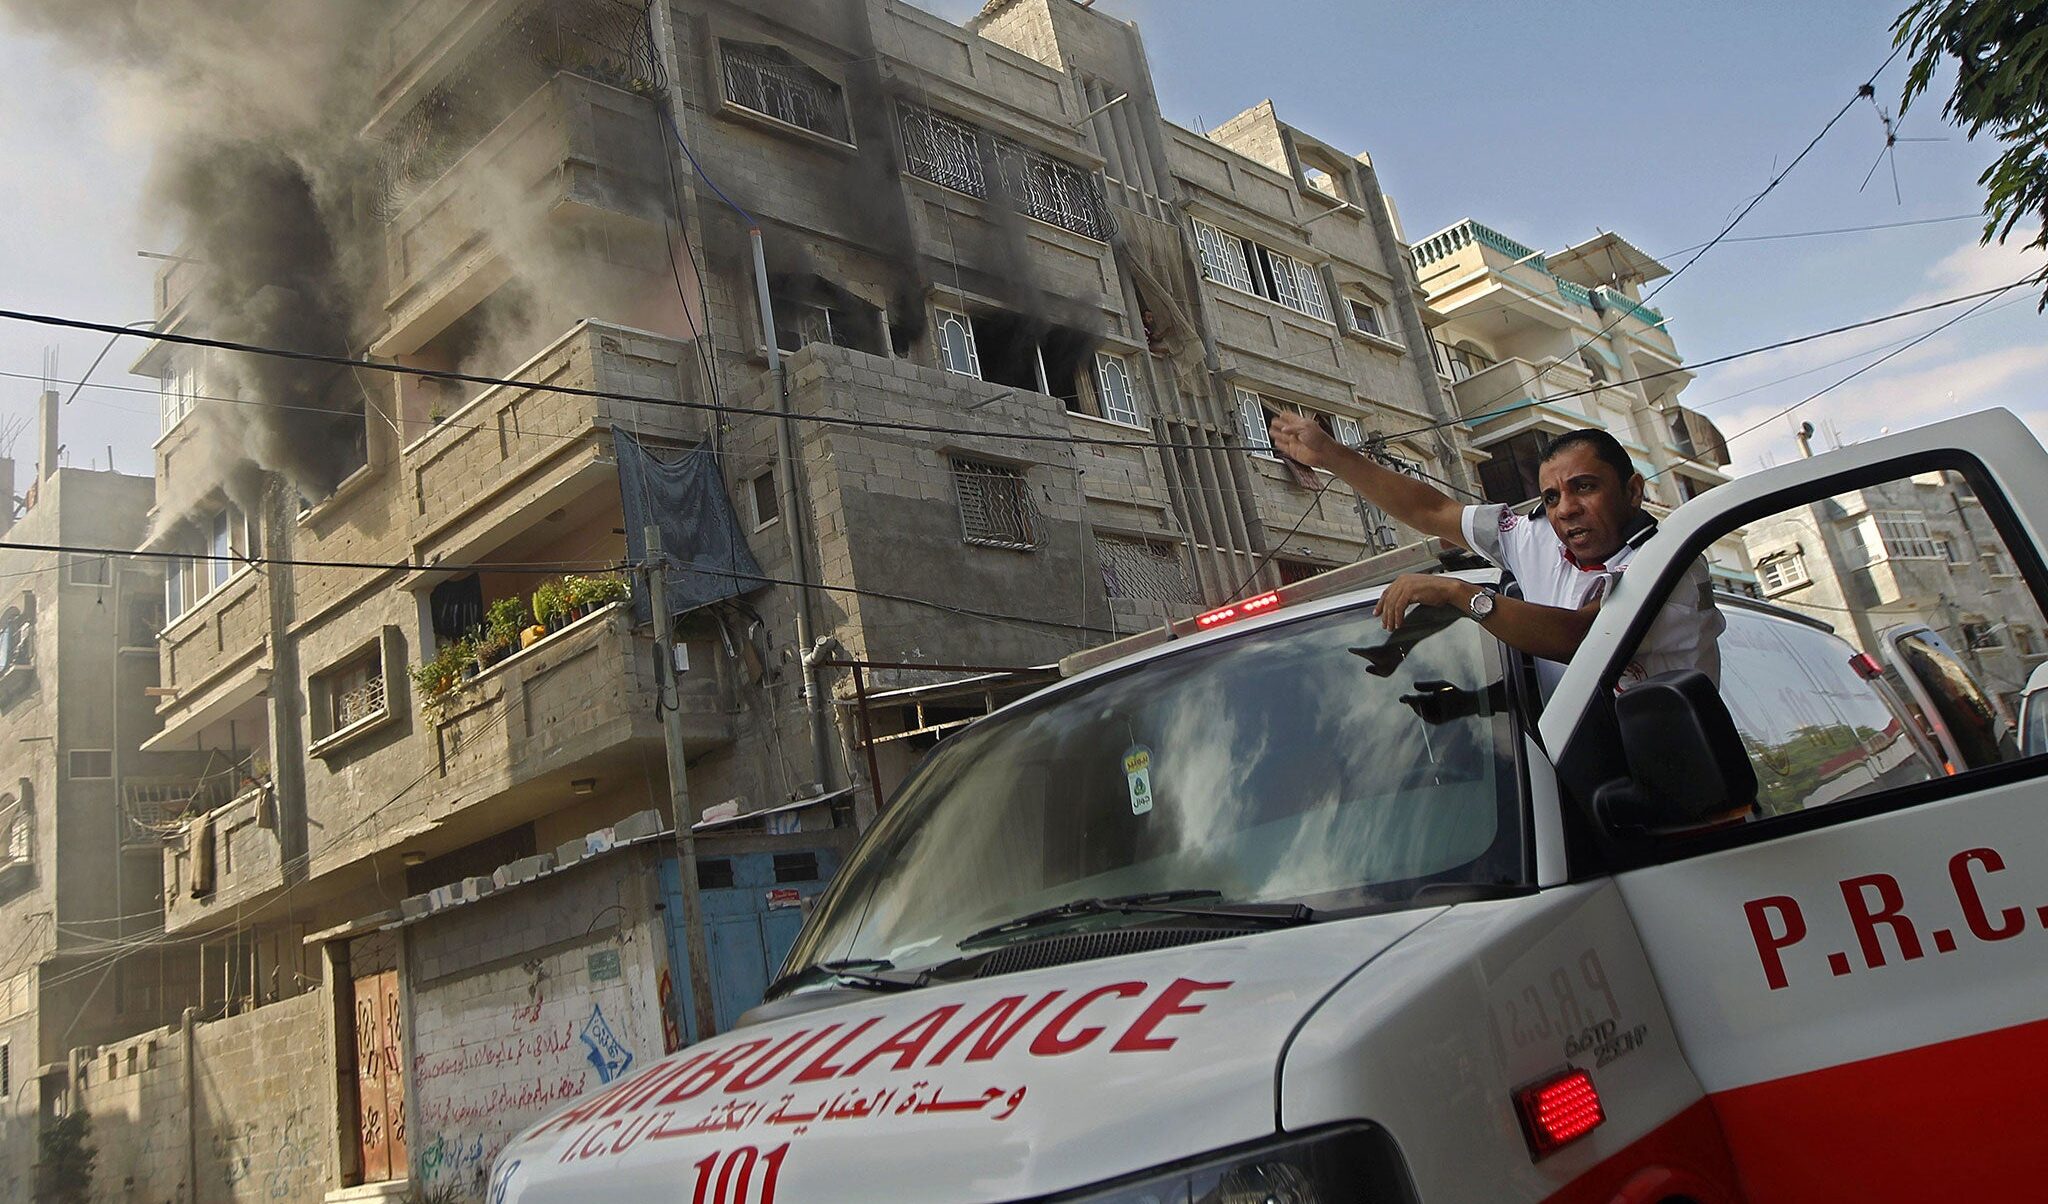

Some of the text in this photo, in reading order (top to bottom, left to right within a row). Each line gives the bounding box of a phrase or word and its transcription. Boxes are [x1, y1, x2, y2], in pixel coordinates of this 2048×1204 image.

[526, 976, 1234, 1142] AMBULANCE
[763, 1087, 899, 1136] العناية
[692, 1141, 791, 1204] 101
